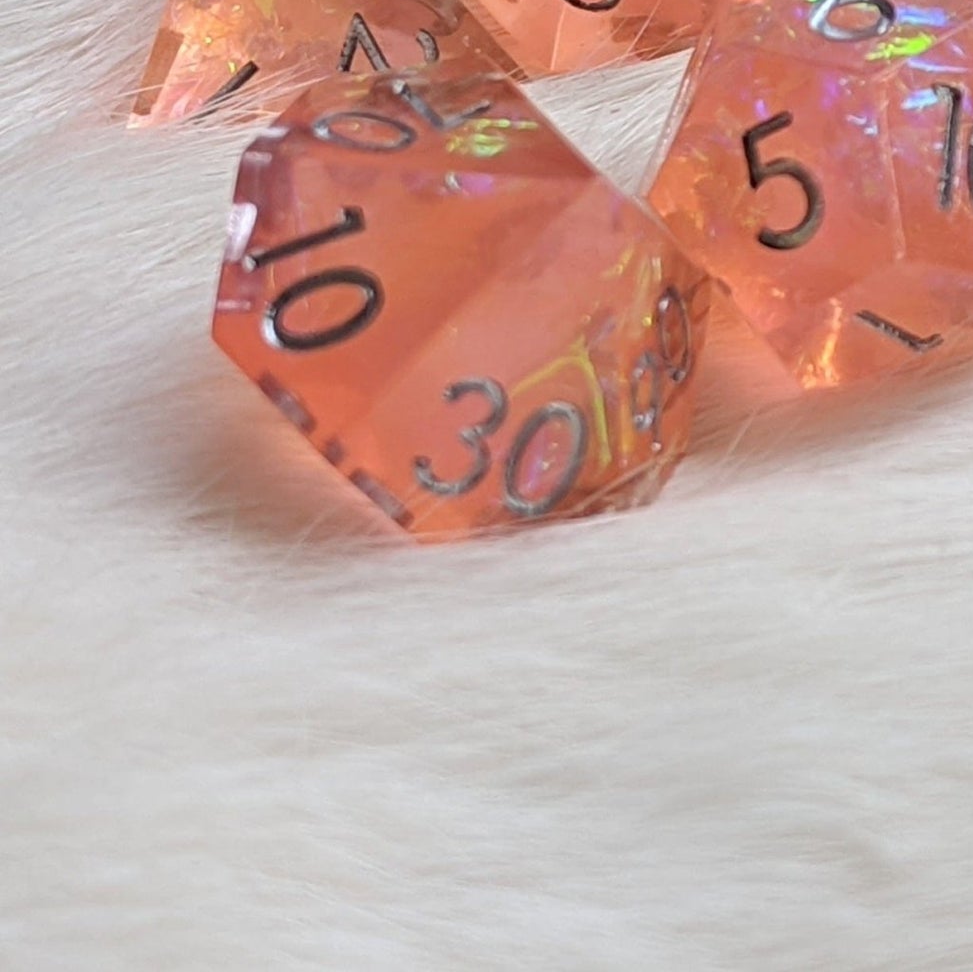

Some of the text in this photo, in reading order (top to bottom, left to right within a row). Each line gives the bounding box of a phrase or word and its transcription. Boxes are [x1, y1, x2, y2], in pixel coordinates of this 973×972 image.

[742, 111, 826, 250] 5
[243, 206, 384, 353] 10
[413, 377, 588, 517] 30
